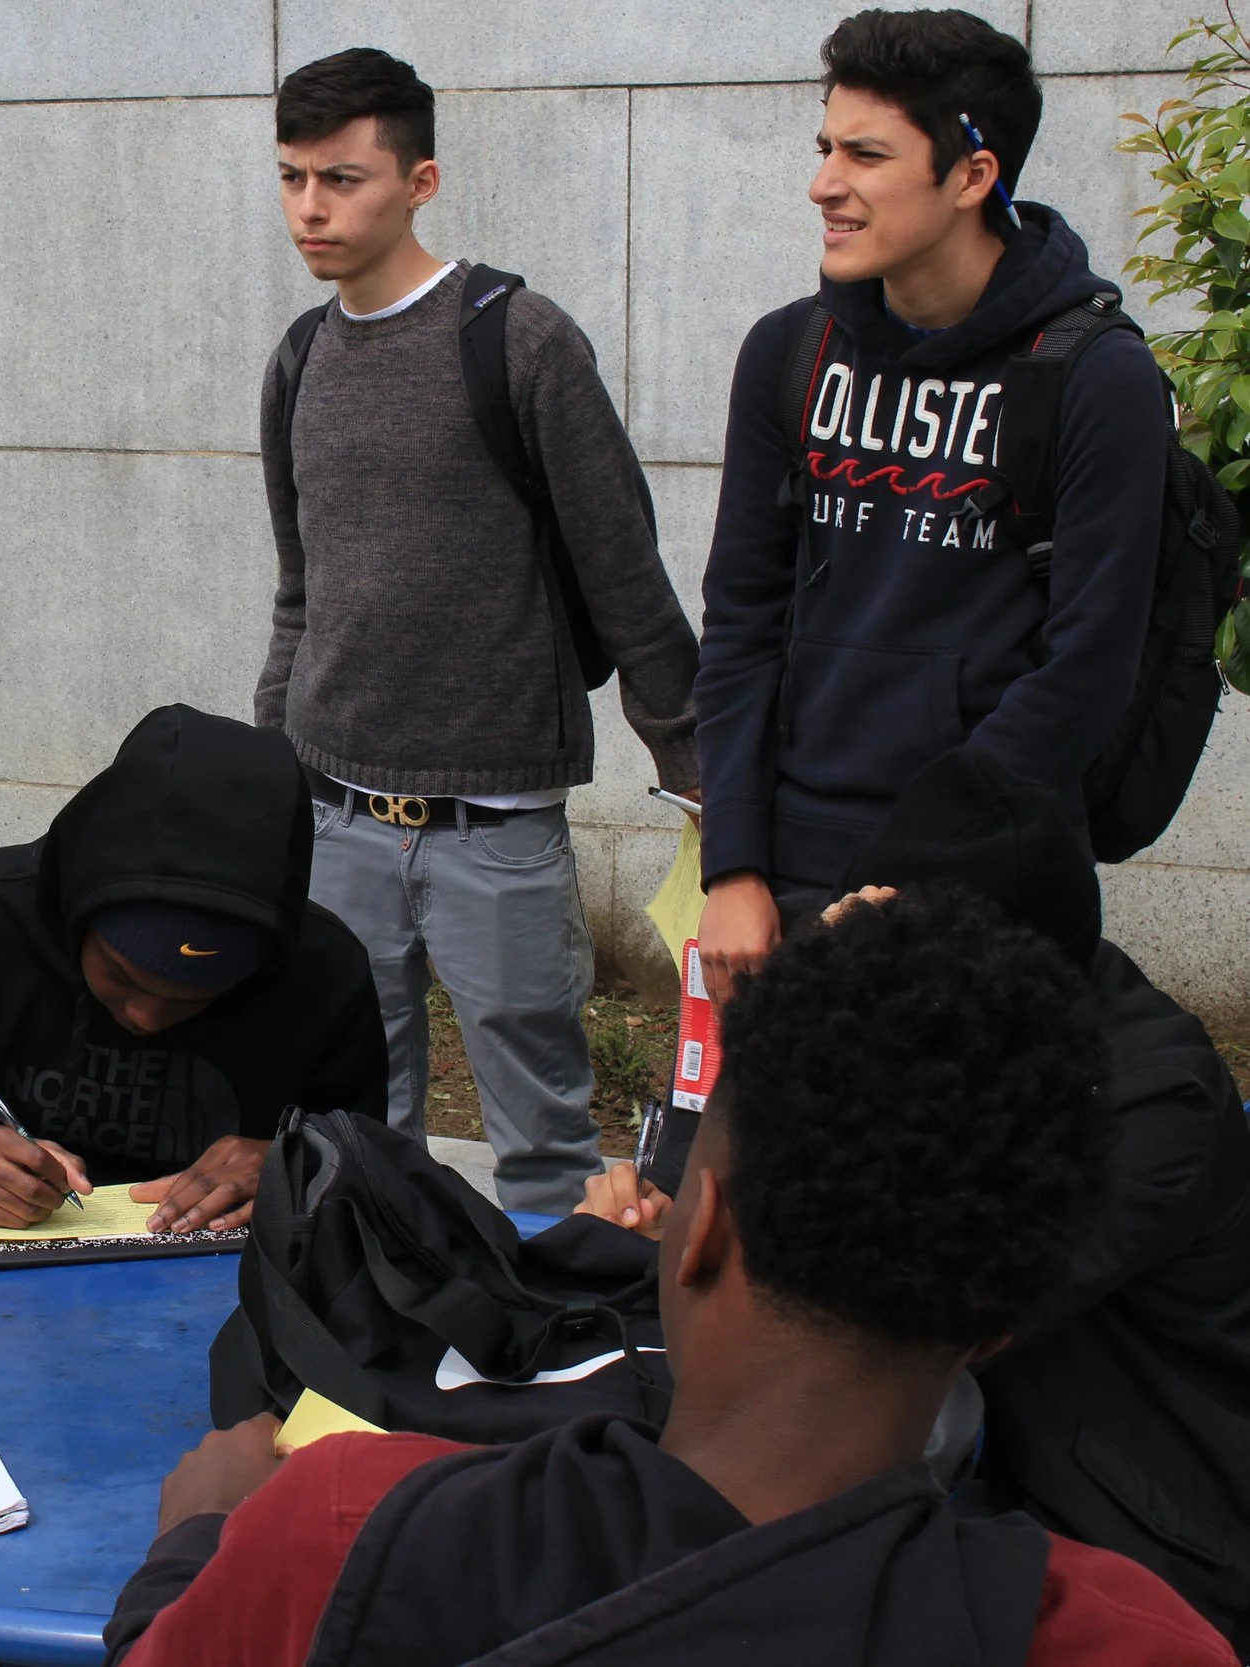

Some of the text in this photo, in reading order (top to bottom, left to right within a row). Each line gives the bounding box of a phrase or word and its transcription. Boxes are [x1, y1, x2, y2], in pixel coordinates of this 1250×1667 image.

[810, 362, 1004, 468] OLLISTE
[812, 493, 998, 550] URF TEAM
[84, 1042, 167, 1086] THE
[4, 1065, 162, 1123] NORTH
[40, 1109, 156, 1159] FACE
